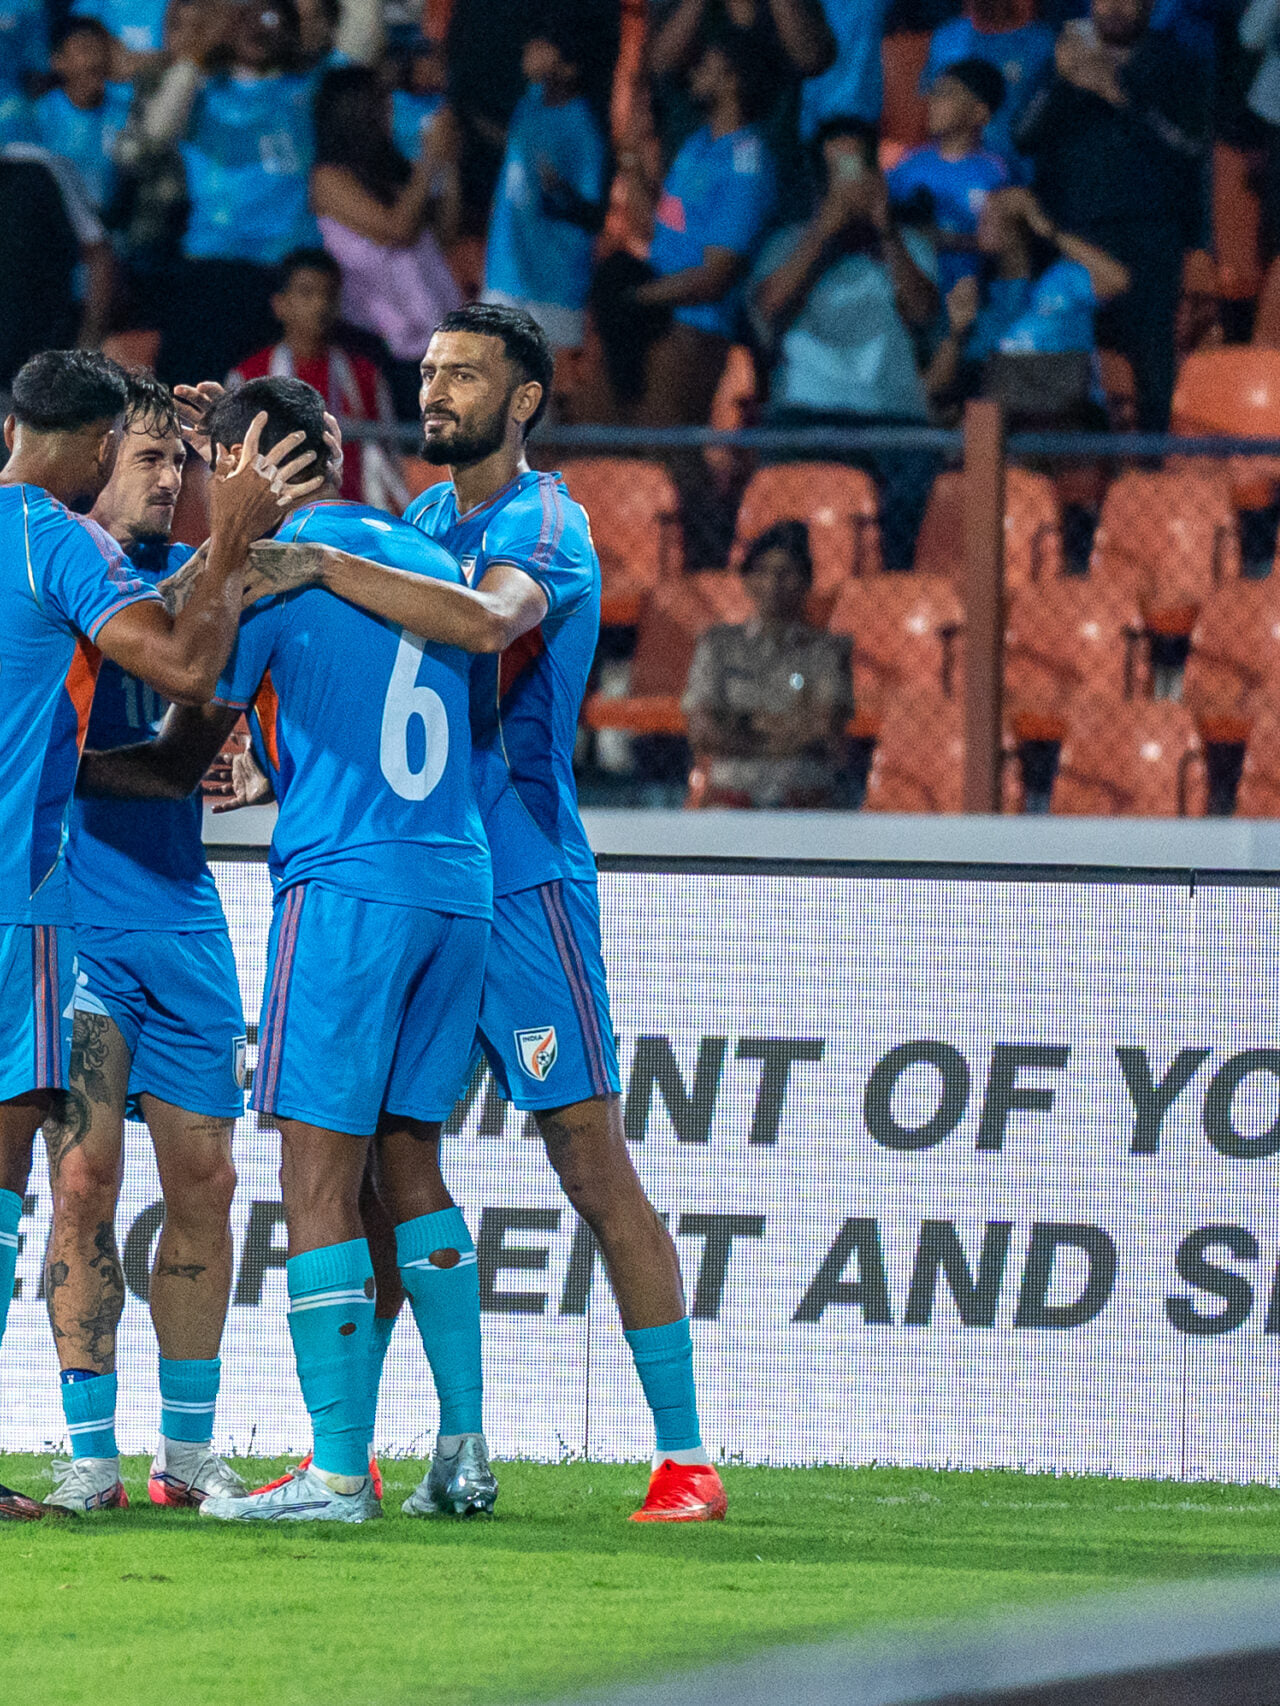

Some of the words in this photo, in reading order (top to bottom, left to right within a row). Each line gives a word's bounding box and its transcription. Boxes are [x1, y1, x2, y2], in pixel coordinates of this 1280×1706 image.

[380, 629, 449, 801] 6
[864, 1039, 1070, 1151] OF
[1115, 1046, 1280, 1159] YO
[790, 1216, 1120, 1330] AND
[1165, 1222, 1280, 1336] S
